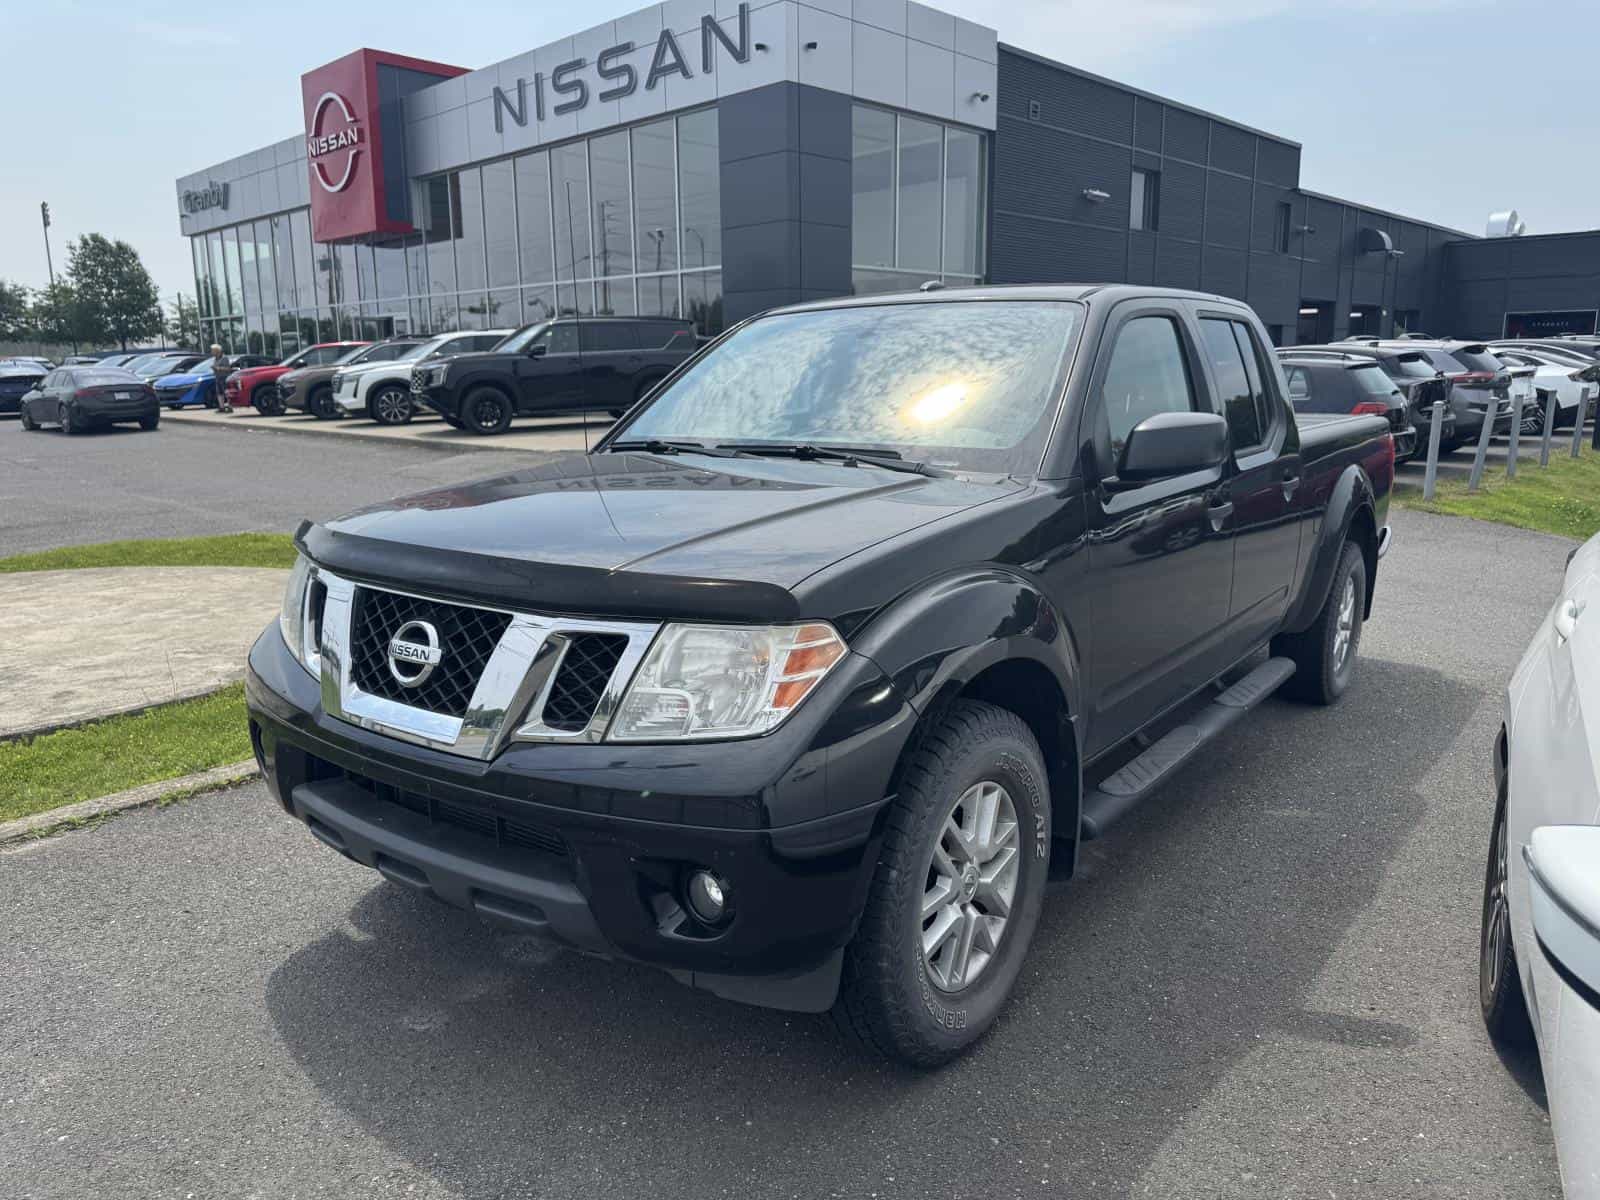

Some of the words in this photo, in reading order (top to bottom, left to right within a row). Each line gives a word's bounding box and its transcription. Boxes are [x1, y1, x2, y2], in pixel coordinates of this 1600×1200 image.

[492, 2, 751, 134] NISSAN
[308, 127, 358, 159] NISSAN
[390, 643, 430, 661] NISSAN
